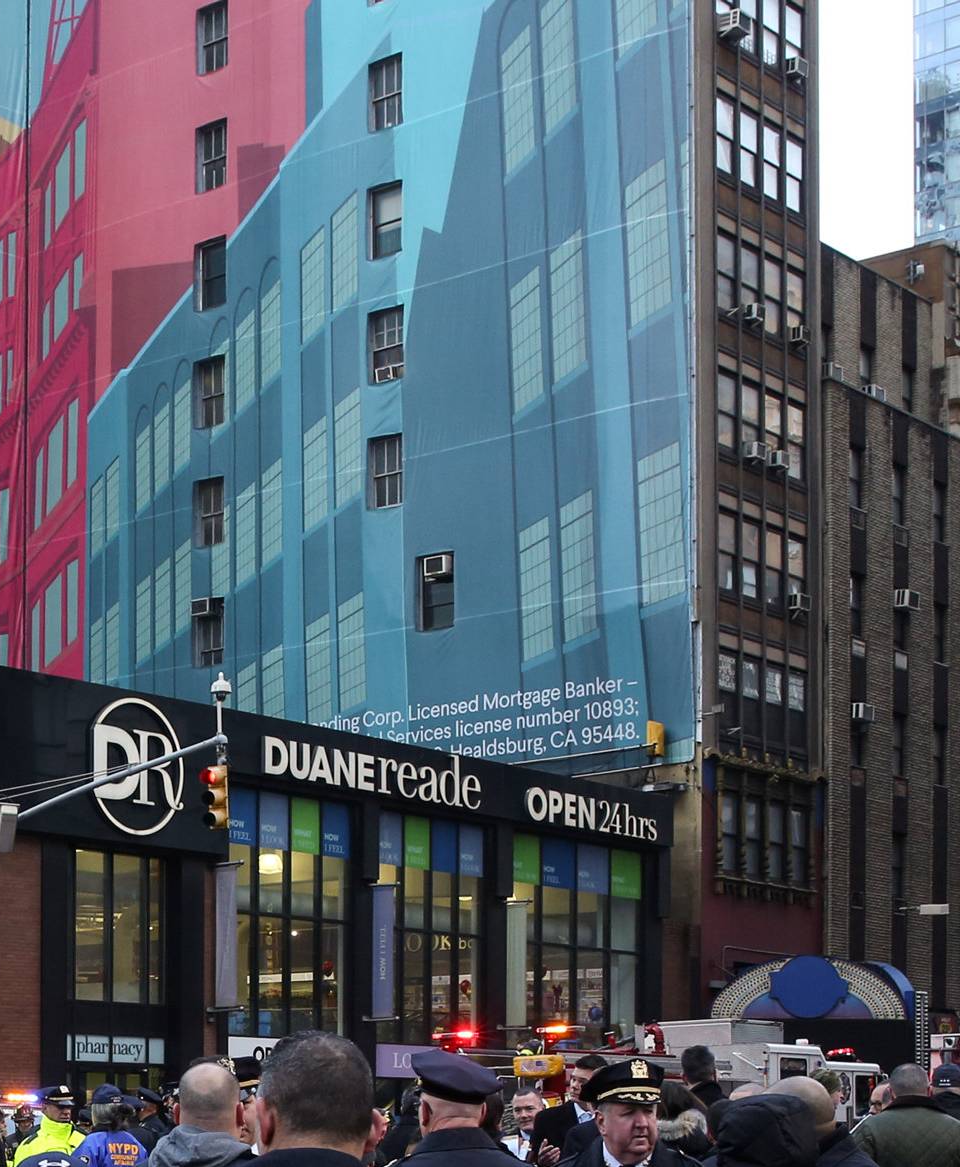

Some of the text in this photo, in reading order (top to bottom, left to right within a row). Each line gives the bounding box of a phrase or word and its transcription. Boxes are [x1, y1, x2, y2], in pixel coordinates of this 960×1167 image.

[362, 710, 405, 729] Corp.
[408, 694, 479, 721] Licensed
[483, 685, 561, 711] Mortgage
[565, 676, 623, 699] Banker
[387, 712, 451, 744] Services
[455, 715, 513, 738] license
[516, 707, 581, 729] number
[584, 697, 639, 721] 10893;
[550, 730, 577, 749] CA
[581, 721, 640, 745] 95448.
[526, 787, 596, 831] OPEN
[76, 1036, 143, 1061] pharmacy
[108, 1143, 139, 1155] NYPD
